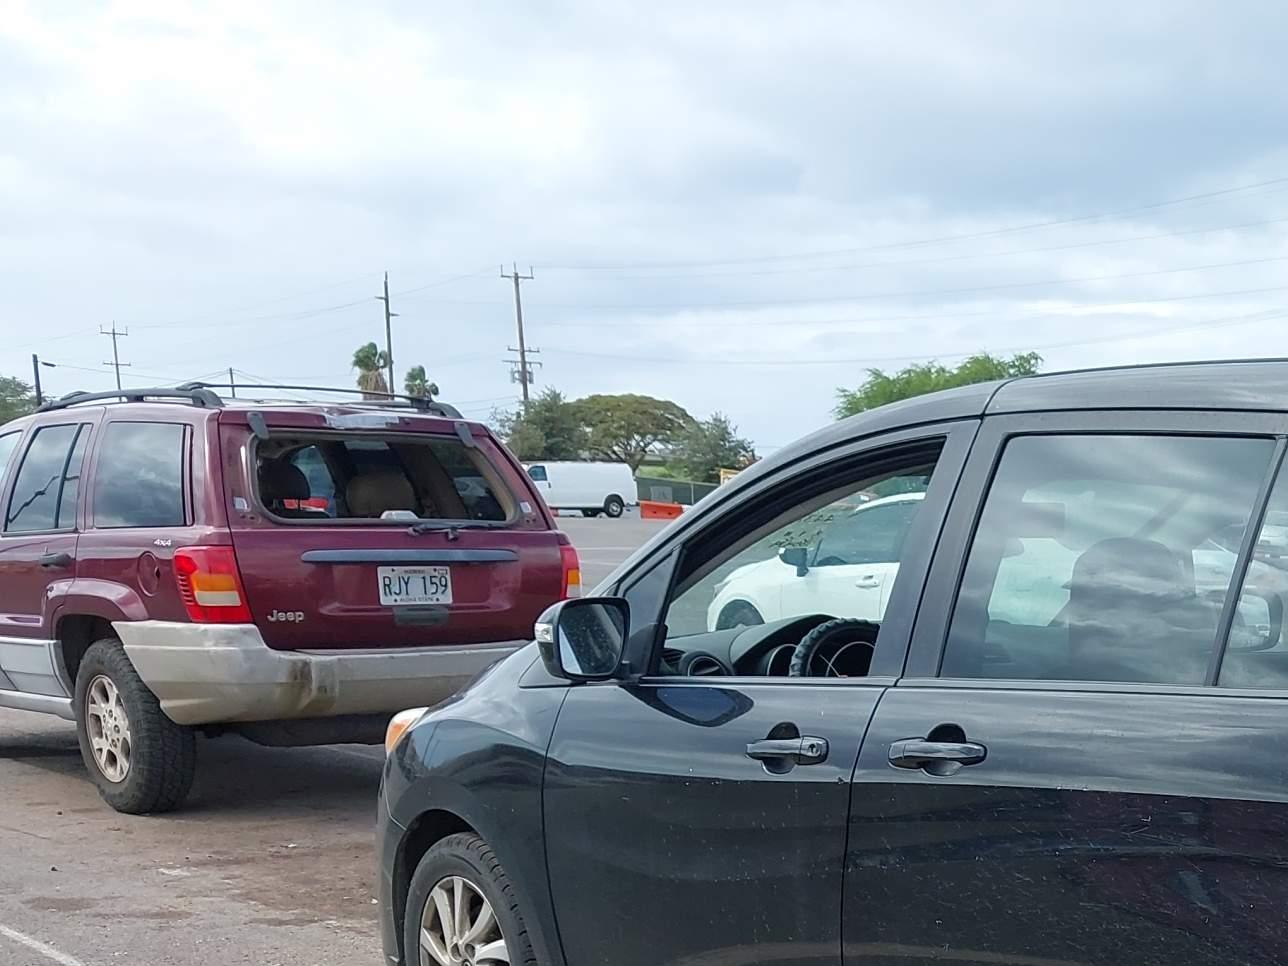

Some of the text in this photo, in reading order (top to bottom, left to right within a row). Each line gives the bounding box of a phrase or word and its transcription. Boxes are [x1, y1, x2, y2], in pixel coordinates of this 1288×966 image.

[383, 575, 448, 597] RJY 159
[266, 609, 305, 624] Jeep
